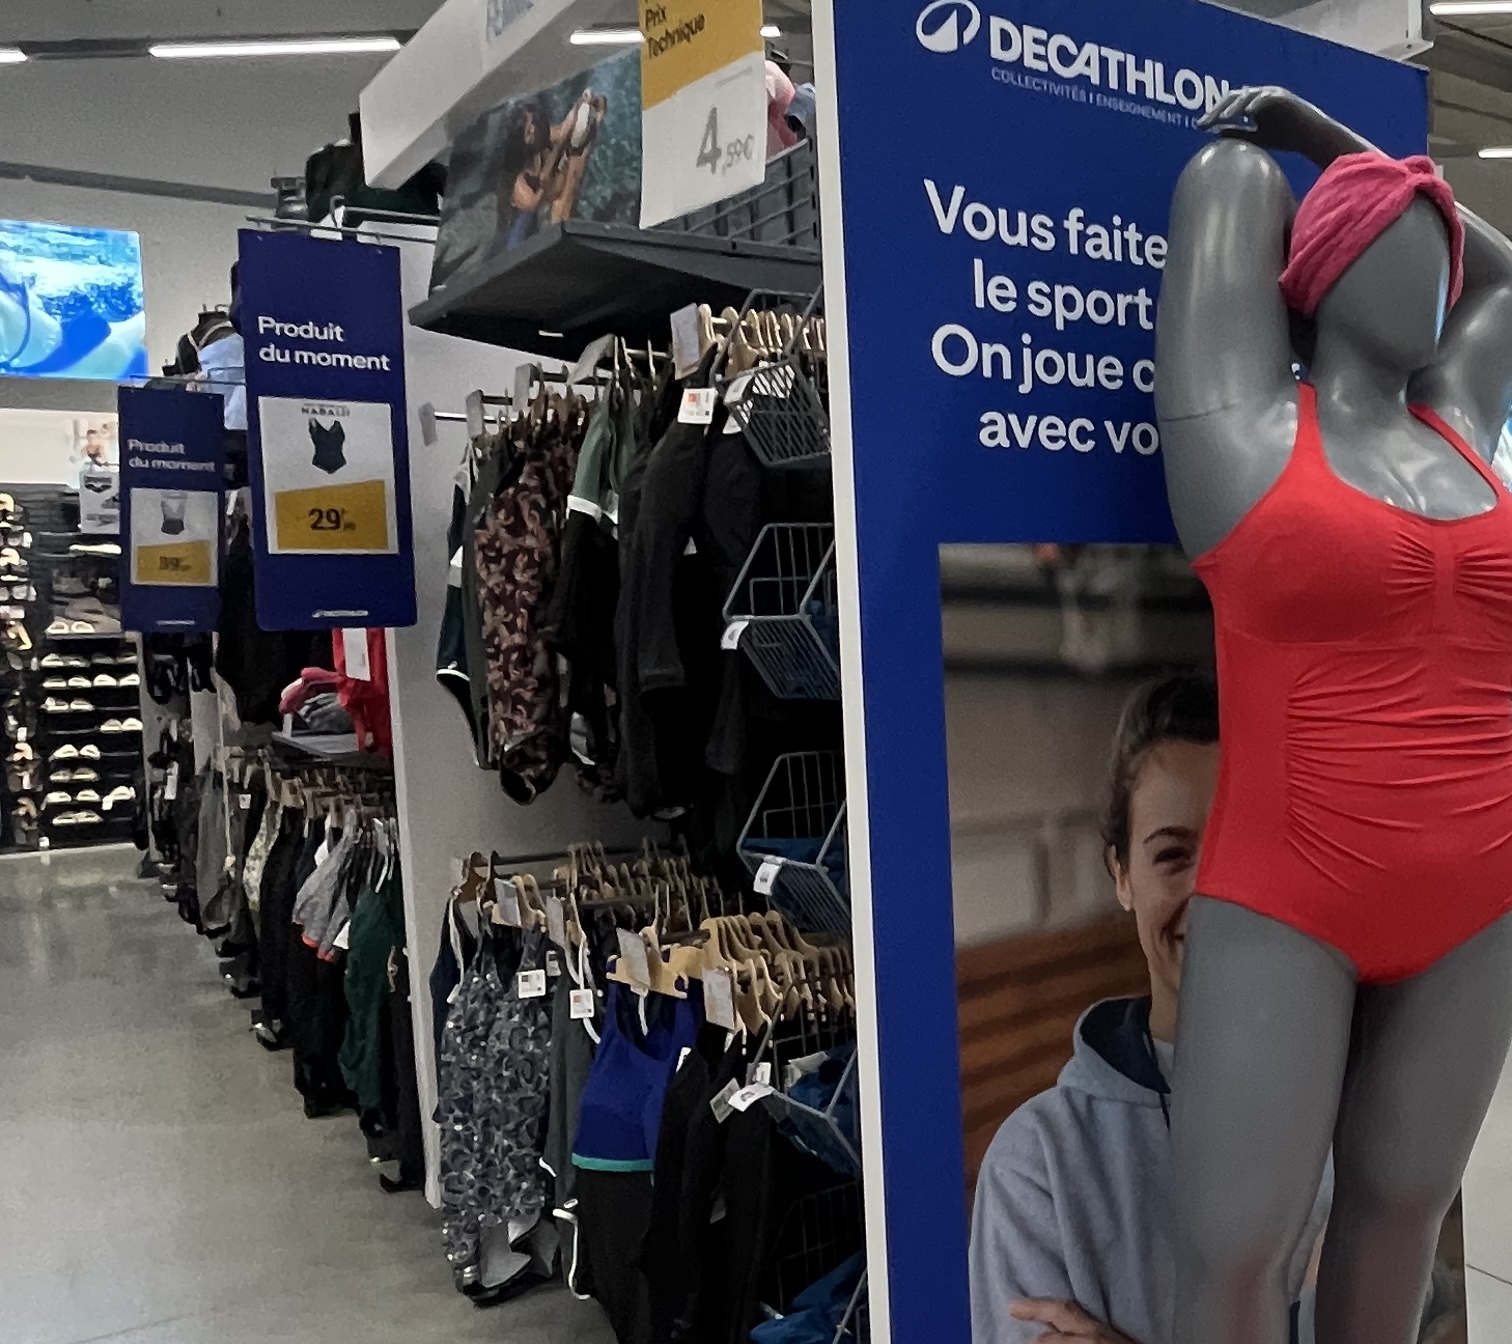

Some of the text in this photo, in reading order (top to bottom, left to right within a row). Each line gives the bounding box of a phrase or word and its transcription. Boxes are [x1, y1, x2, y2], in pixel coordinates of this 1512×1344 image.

[989, 14, 1230, 112] DECATHLON
[923, 178, 1169, 271] Vous faite
[972, 258, 1153, 331] le sport
[258, 315, 344, 342] Produit
[258, 343, 391, 372] du moment
[931, 322, 1013, 379] On
[1018, 335, 1124, 395] joue
[127, 438, 186, 455] Produit
[978, 409, 1160, 456] avec vo
